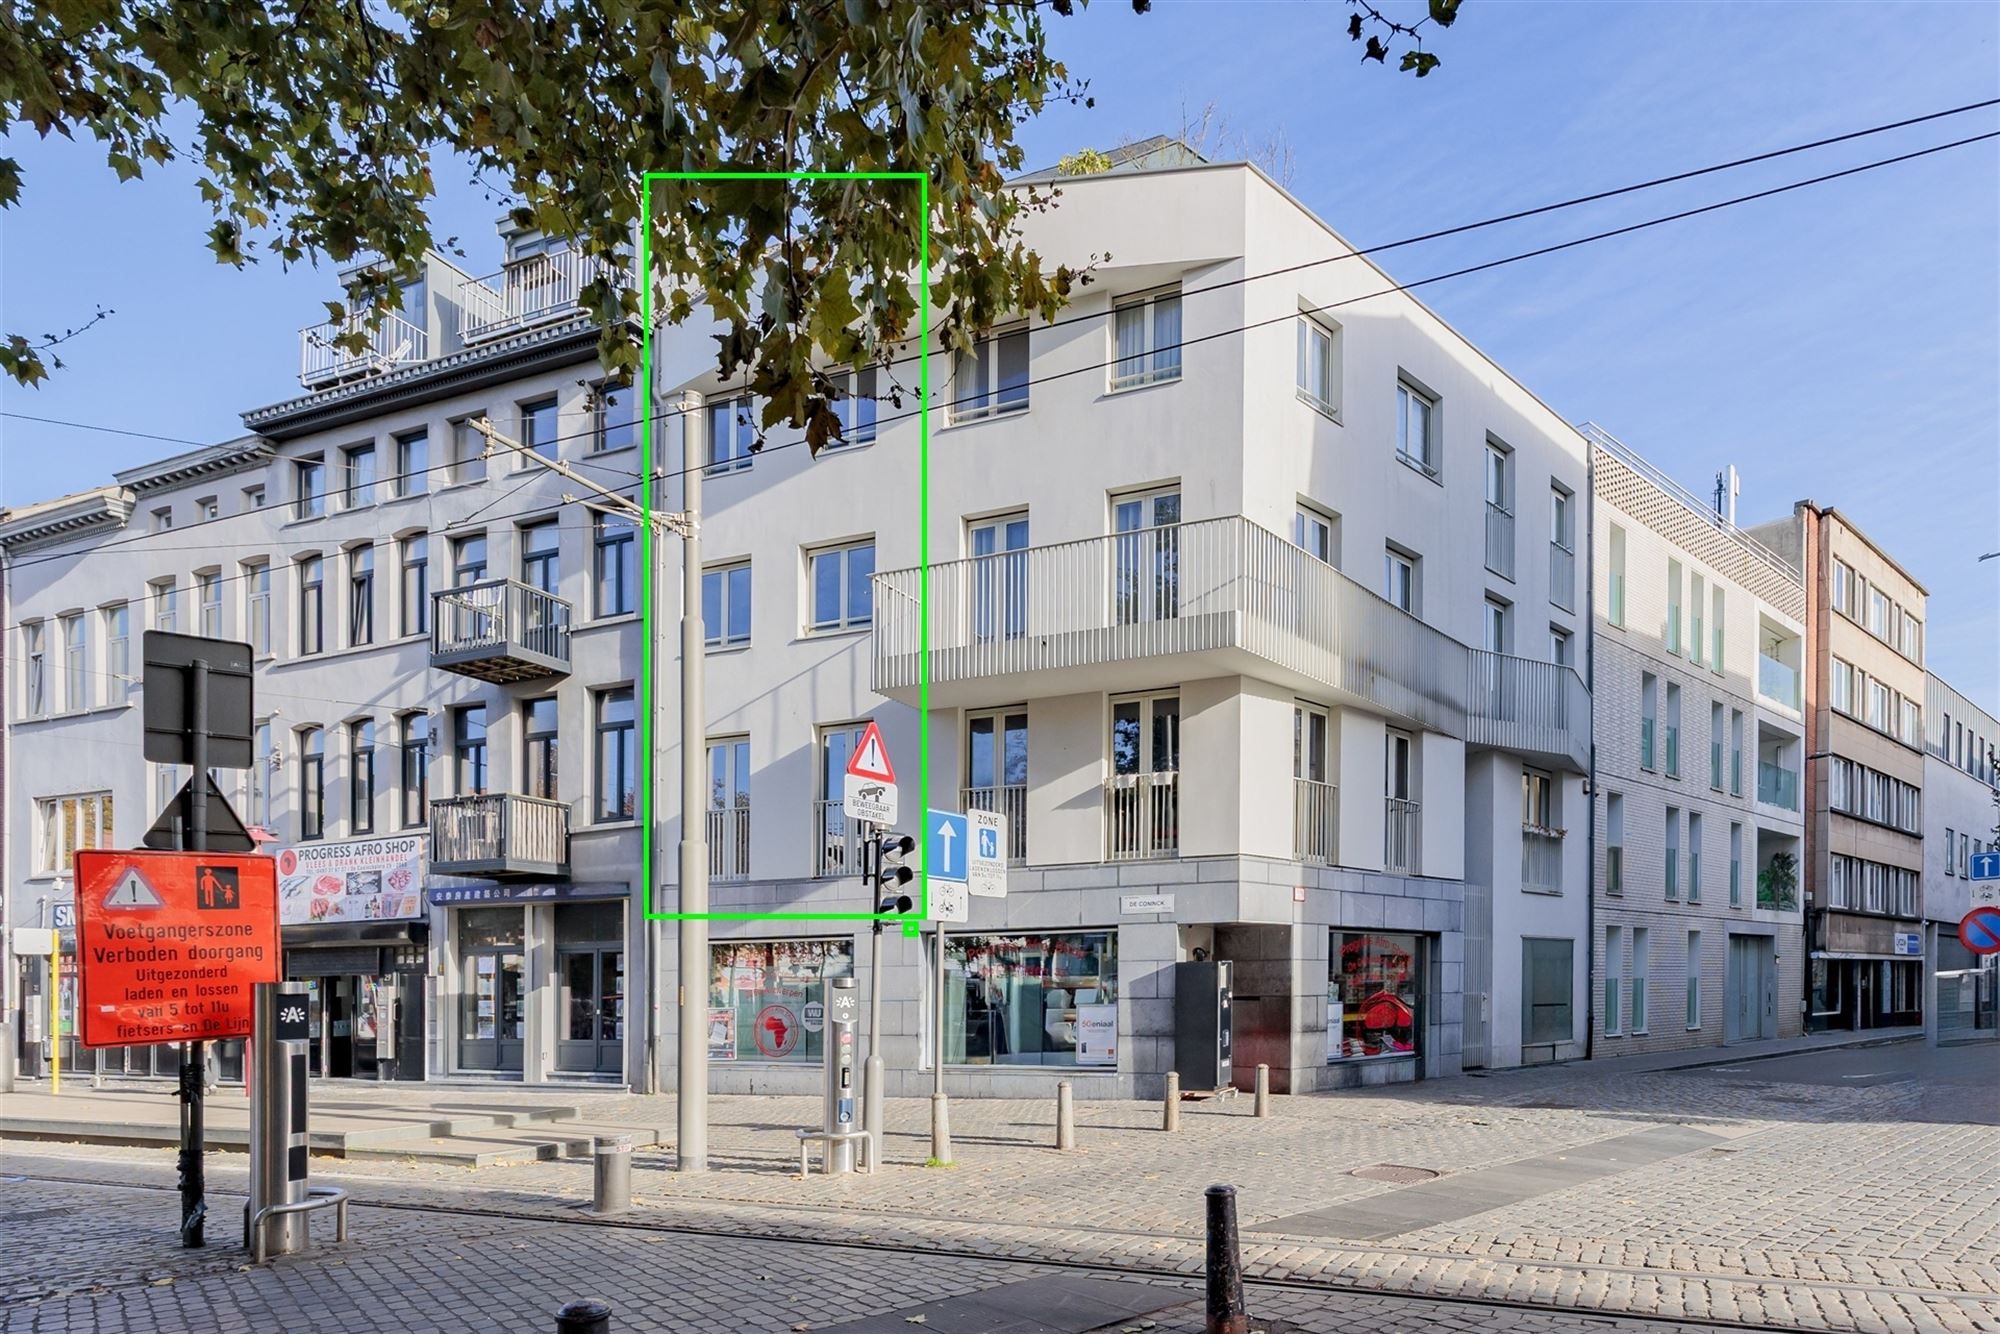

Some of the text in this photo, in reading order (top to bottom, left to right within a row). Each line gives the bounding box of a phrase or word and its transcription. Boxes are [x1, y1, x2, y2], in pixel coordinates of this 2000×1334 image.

[852, 799, 890, 813] BEWEEGBAAR
[857, 808, 885, 820] OBSTAKEL
[977, 814, 998, 827] ZONE
[298, 840, 416, 862] PROGRESS AFRO SHOP
[306, 860, 326, 868] VLEES
[334, 859, 357, 867] DRANK
[360, 854, 408, 864] KLEINHANDEL
[104, 924, 253, 942] Voetgangerszone
[93, 945, 263, 963] Verboden doorgang
[136, 966, 228, 983] Uitgezonderd
[125, 984, 239, 1001] laden en lossen
[138, 1006, 163, 1019] van
[170, 1003, 178, 1016] 5
[185, 1003, 204, 1015] tot
[117, 1016, 249, 1038] fietsers en De Lijn
